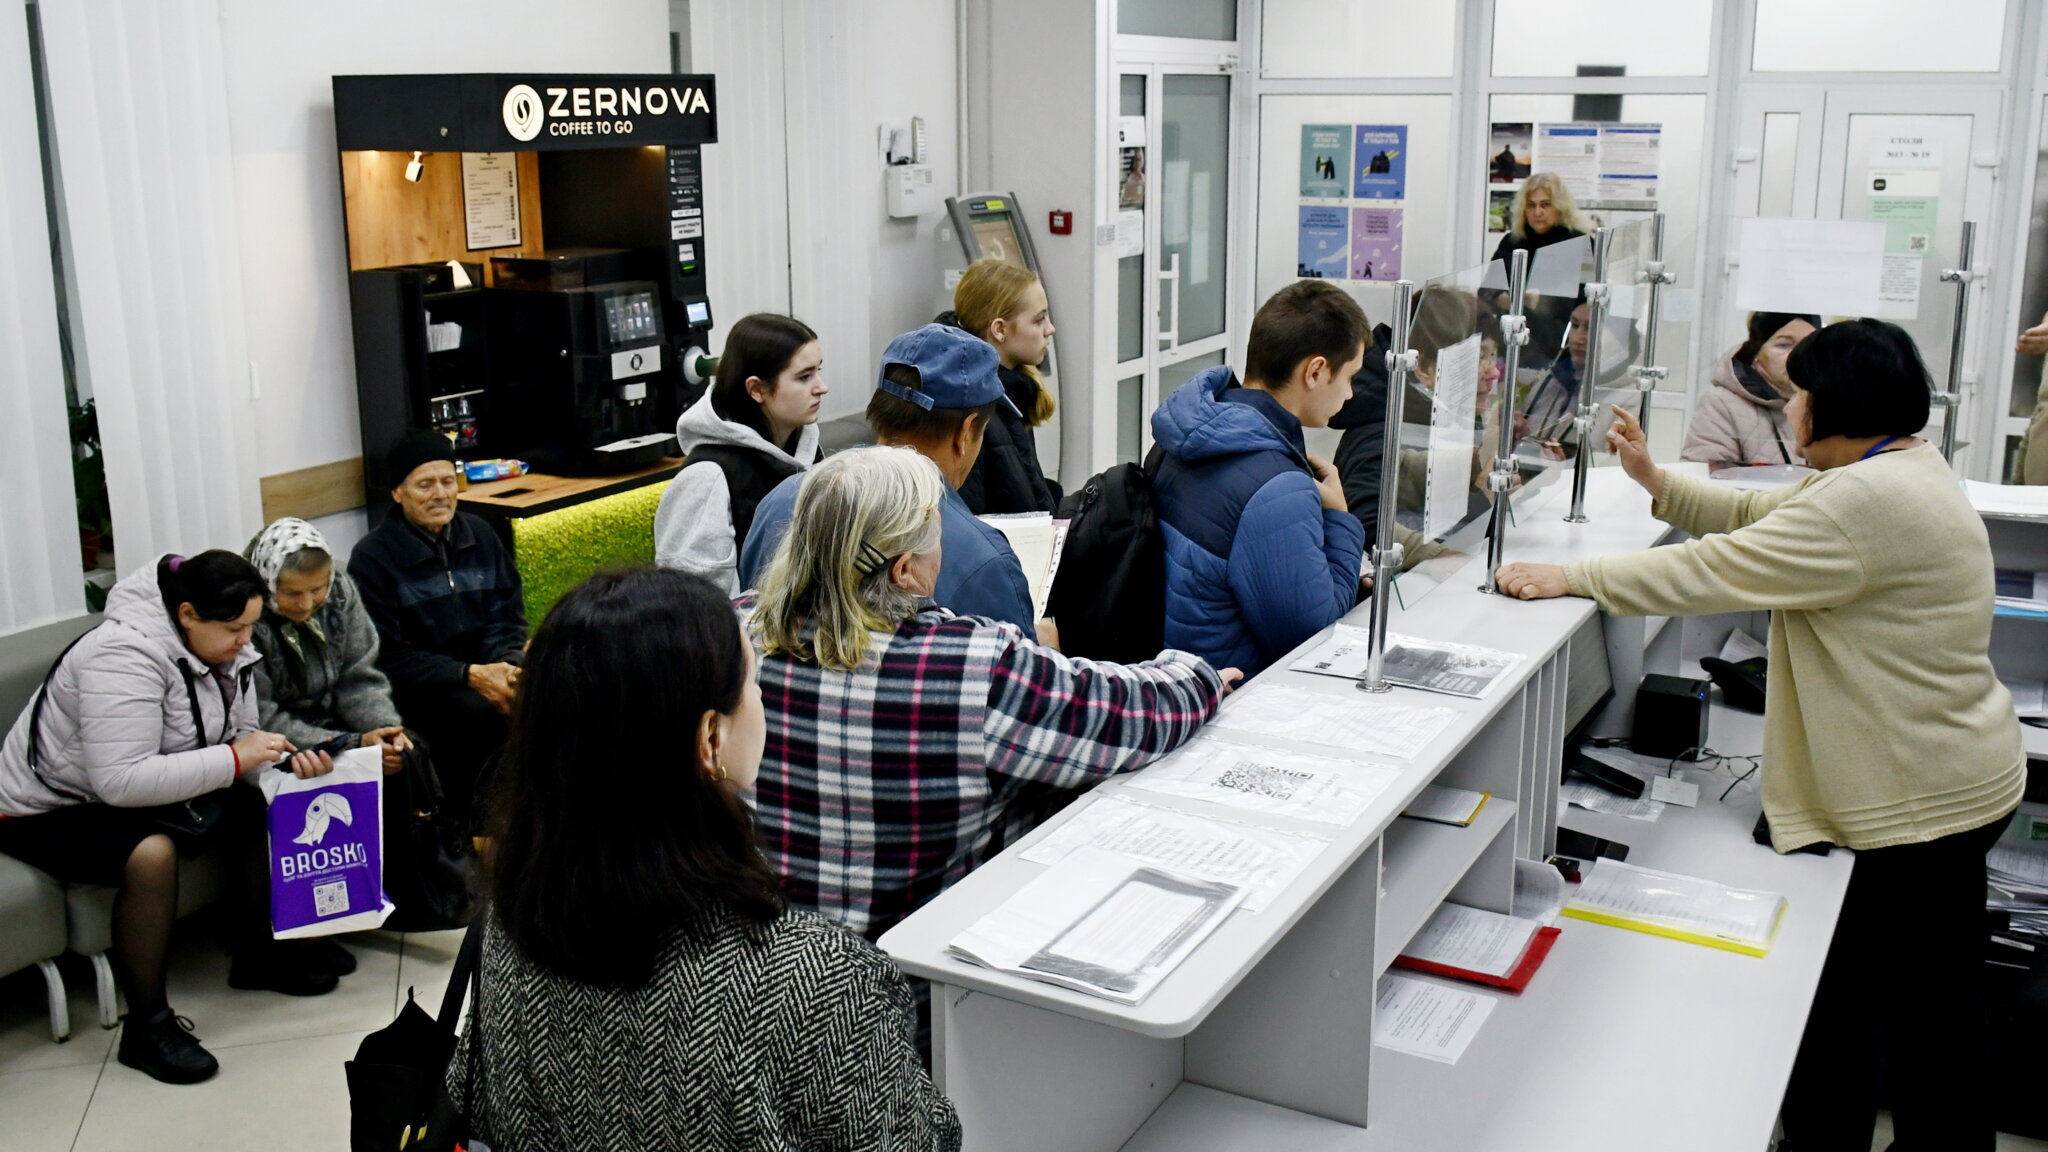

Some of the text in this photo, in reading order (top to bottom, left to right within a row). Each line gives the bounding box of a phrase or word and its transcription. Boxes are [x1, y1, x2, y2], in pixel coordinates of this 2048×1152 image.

[546, 87, 710, 117] ZERNOVA
[550, 120, 633, 136] COFFEE TO GO
[281, 843, 367, 877] BROSKO
